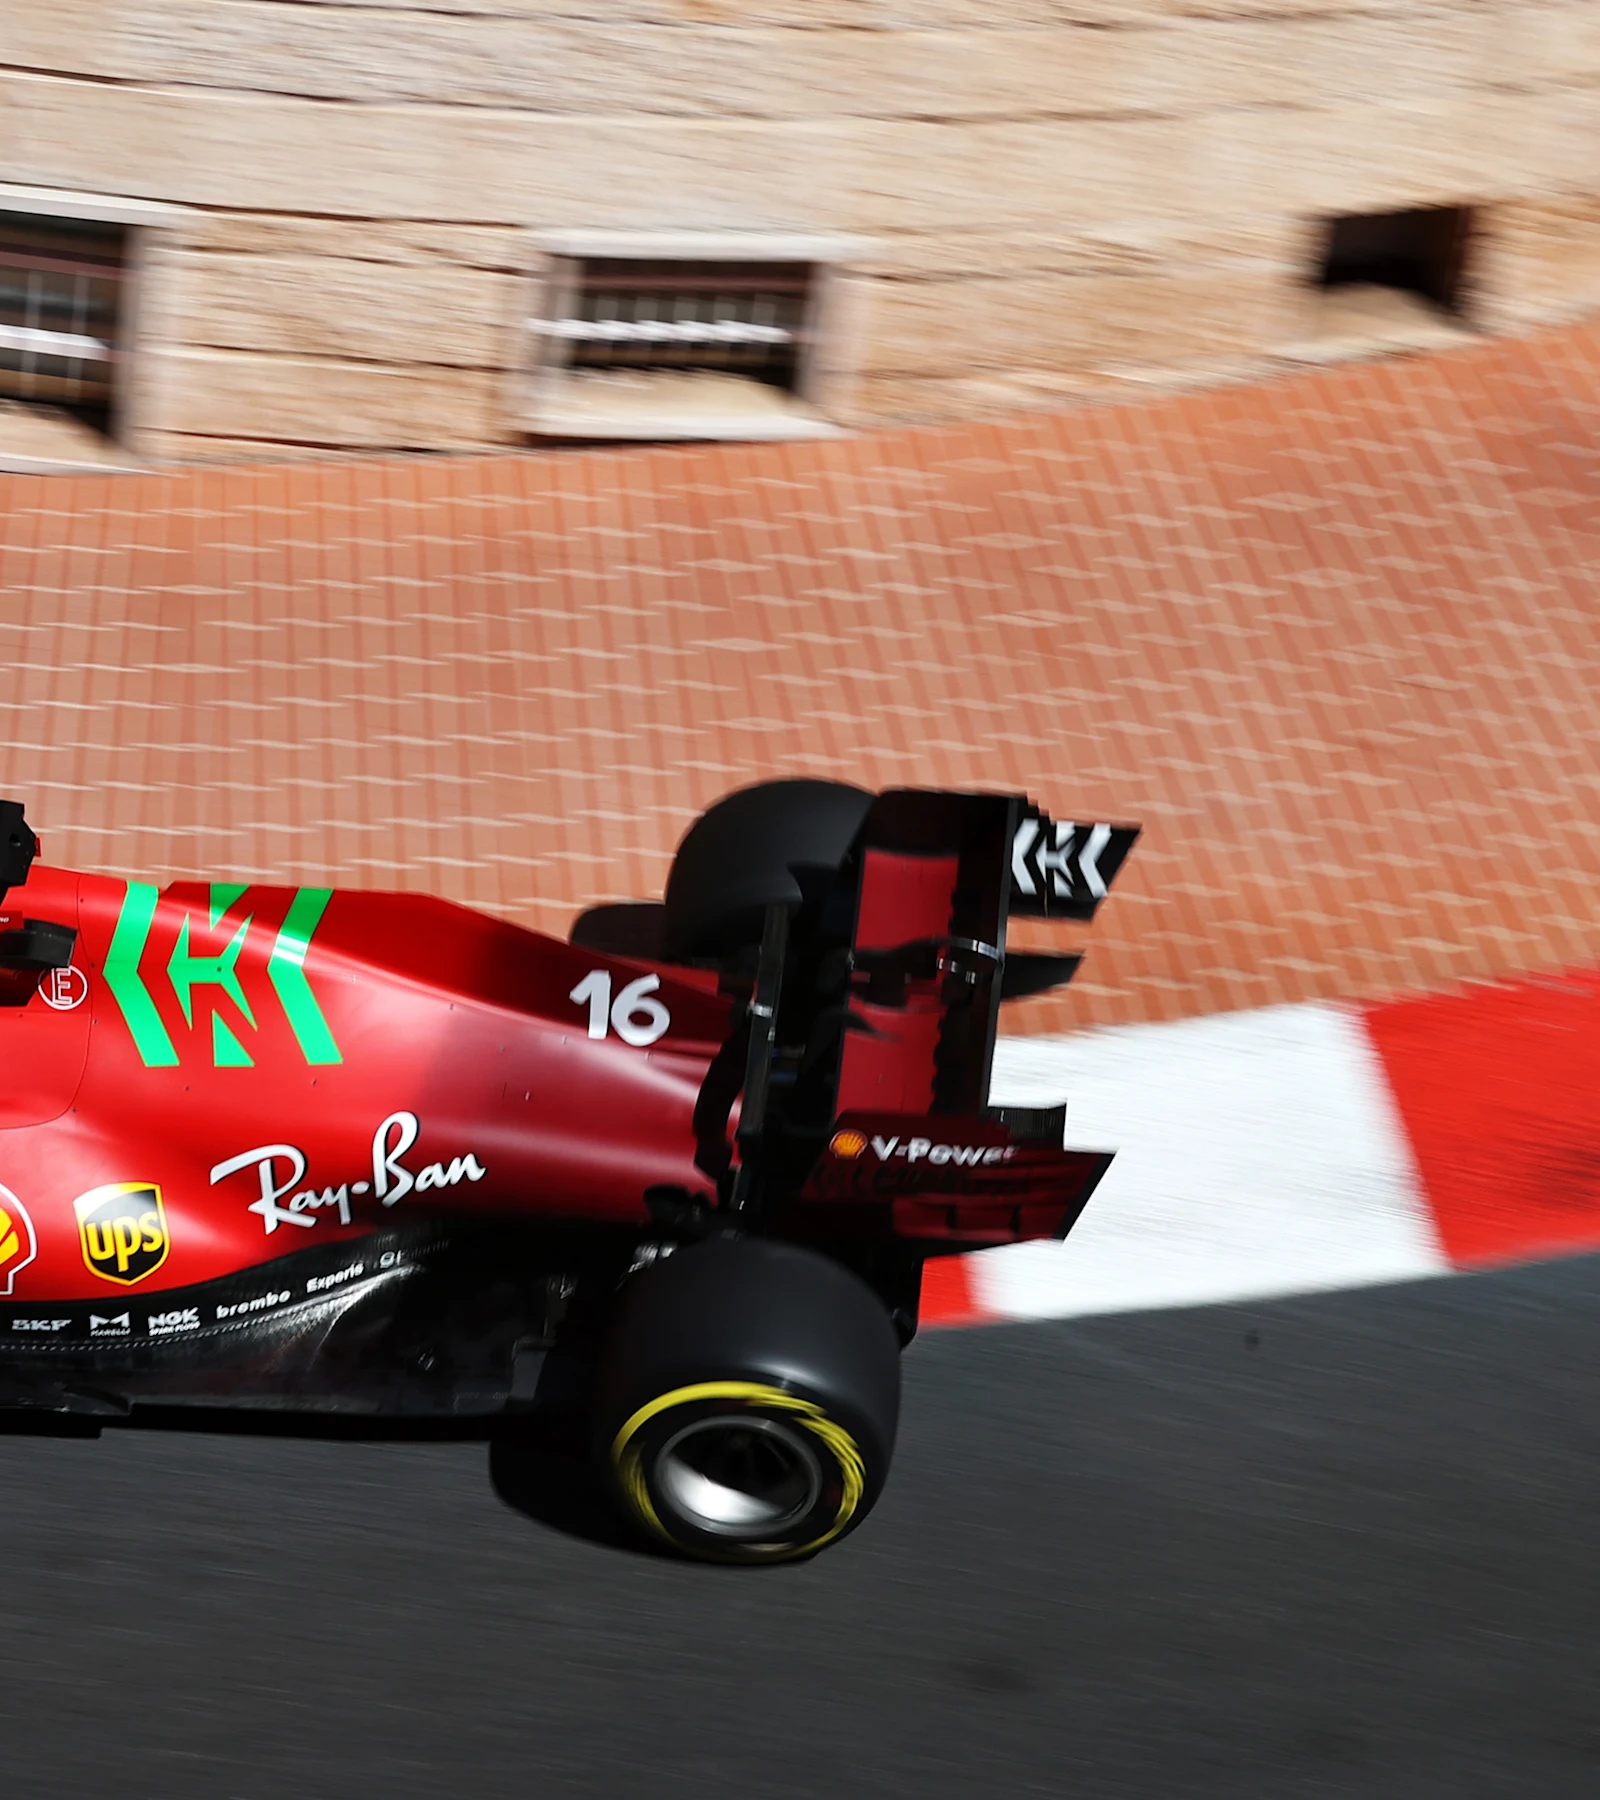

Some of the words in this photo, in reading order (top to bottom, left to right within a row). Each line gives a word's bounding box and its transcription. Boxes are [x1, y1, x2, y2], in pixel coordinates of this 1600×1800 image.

[569, 969, 671, 1047] 16
[871, 1134, 1020, 1168] V-Power
[210, 1111, 486, 1235] Ray-Ban
[86, 1209, 165, 1273] ups
[306, 1262, 364, 1293] Experis
[148, 1306, 200, 1329] NGK
[215, 1289, 291, 1319] brembo
[11, 1319, 72, 1331] SKF
